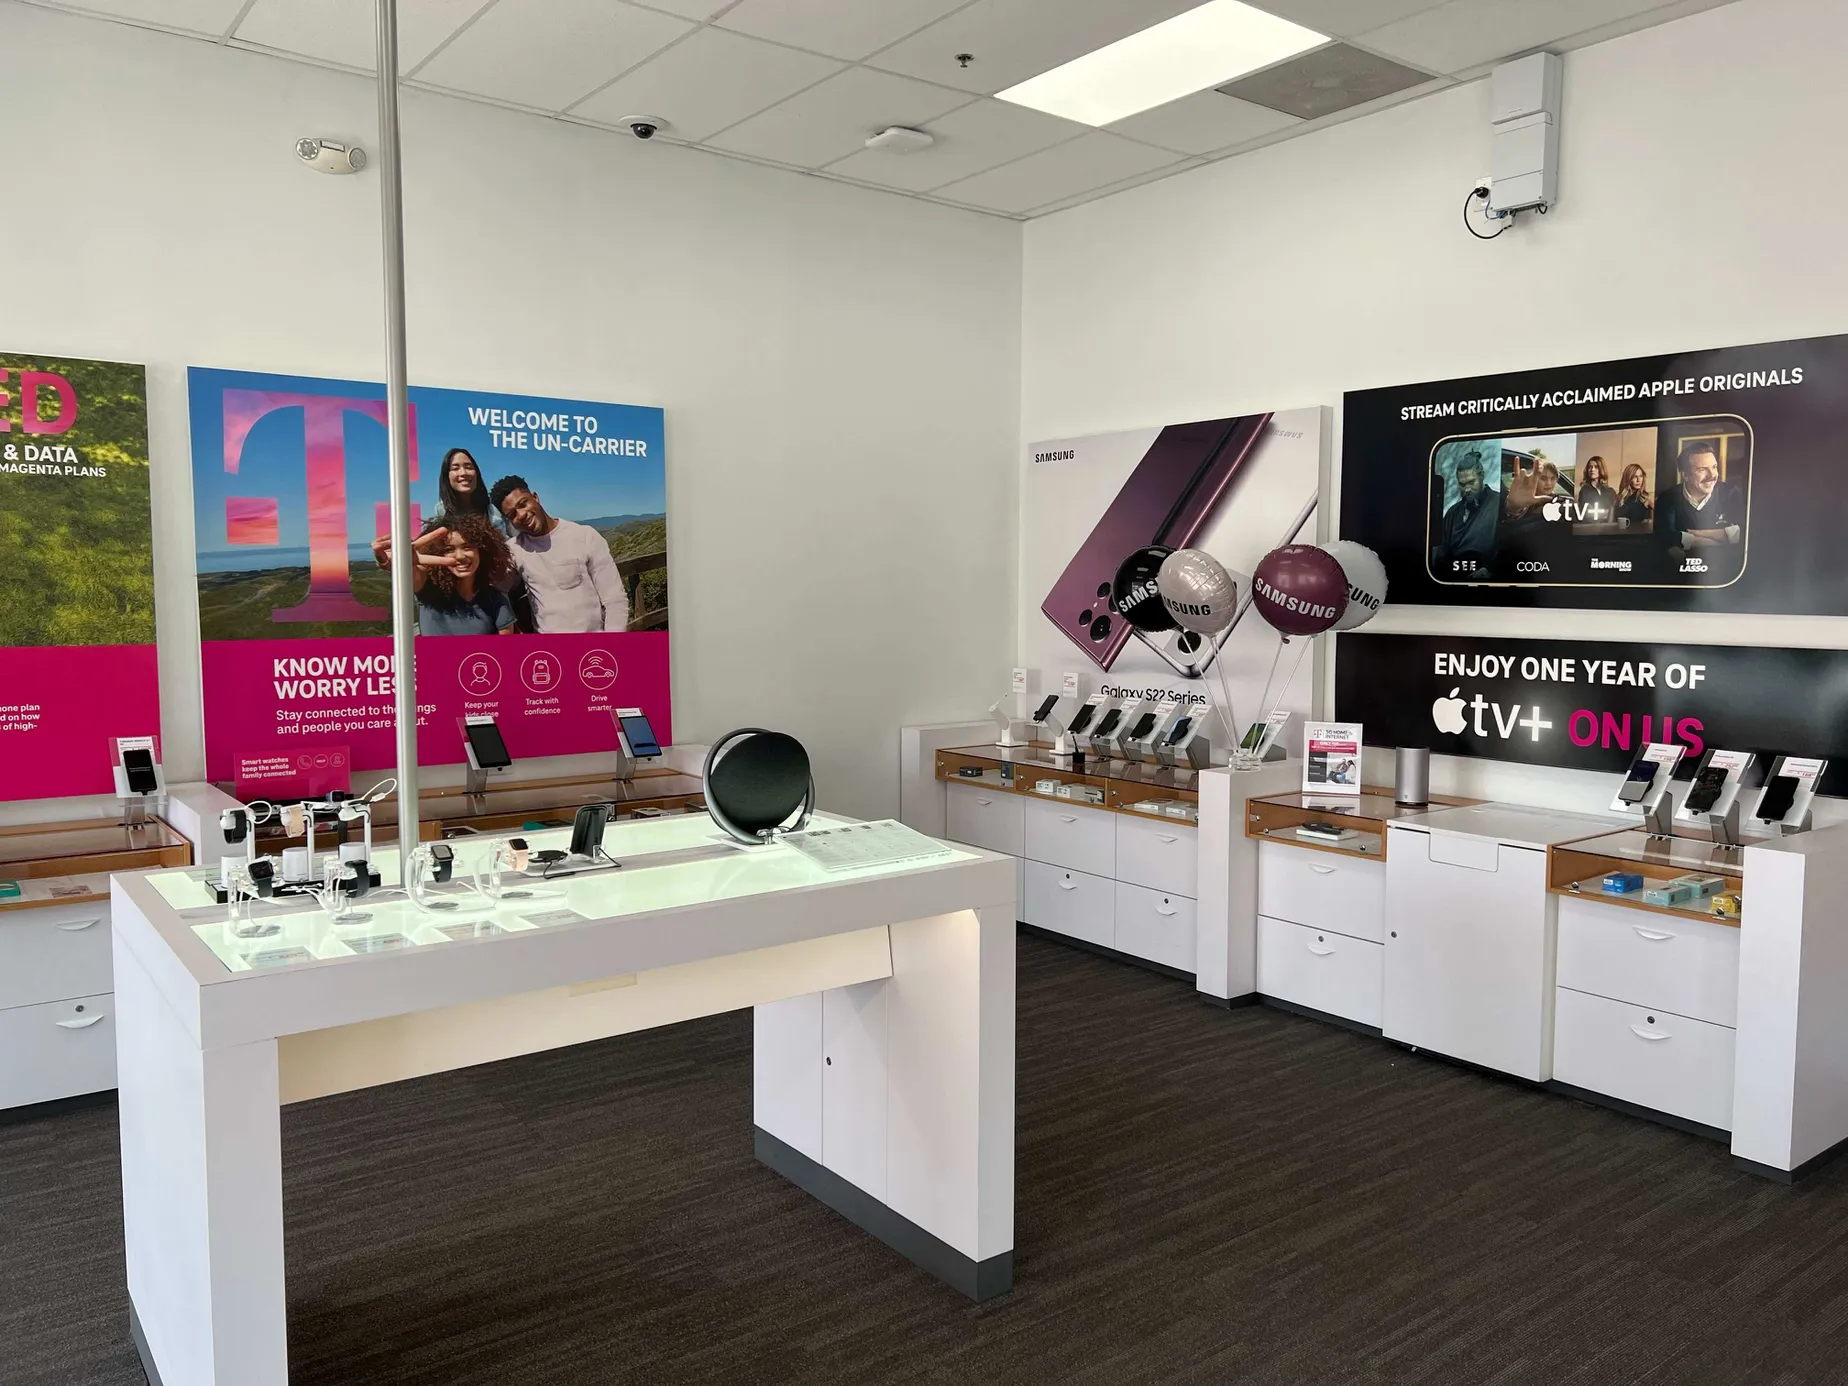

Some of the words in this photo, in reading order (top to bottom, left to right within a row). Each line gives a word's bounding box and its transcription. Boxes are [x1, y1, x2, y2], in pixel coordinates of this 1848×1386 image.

[0, 368, 77, 434] D
[1401, 402, 1454, 420] STREAM
[1457, 394, 1539, 416] CRITICALLY
[1541, 384, 1635, 407] ACCLAIMED
[1638, 378, 1695, 398] APPLE
[1700, 367, 1804, 393] ORIGINALS
[468, 407, 569, 432] WELCOME
[573, 416, 598, 434] TO
[489, 429, 528, 450] THE
[533, 433, 647, 457] UN-CARRIER
[4, 444, 18, 460] &
[25, 445, 78, 463] DATA
[1035, 449, 1074, 463] SAMSUNG
[0, 463, 62, 475] MAGENTA
[65, 466, 106, 477] PLANS
[1453, 560, 1476, 571] SEE
[1516, 561, 1550, 572] CODA
[1590, 561, 1632, 569] MORNING
[1119, 580, 1158, 612] SAMS
[1255, 577, 1336, 619] SAMSUNG
[1163, 595, 1211, 616] MSUNG
[273, 657, 347, 677] KNOW
[353, 655, 417, 675] MO
[1434, 653, 1516, 678] ENJOY
[1521, 656, 1575, 682] ONE
[1582, 659, 1656, 687] YEAR
[1665, 663, 1706, 689] OF
[273, 677, 361, 699] WORRY
[367, 676, 417, 696] LE
[1101, 685, 1143, 699] Galaxy
[1145, 688, 1165, 701] S22
[1168, 690, 1206, 705] Series
[20, 703, 40, 712] plan
[464, 701, 482, 709] Keep
[483, 701, 499, 709] your
[525, 698, 543, 706] Track
[276, 709, 302, 721] Stay
[305, 706, 366, 719] connected
[368, 706, 380, 715] to
[524, 708, 561, 716] confidence
[3, 722, 12, 730] of
[14, 722, 38, 731] high-
[277, 723, 299, 735] and
[302, 720, 342, 735] people
[344, 721, 365, 733] you
[367, 719, 391, 729] care
[1470, 694, 1553, 741] tv+
[1568, 709, 1631, 750] ON
[1642, 715, 1704, 757] US
[263, 769, 297, 777] connected
